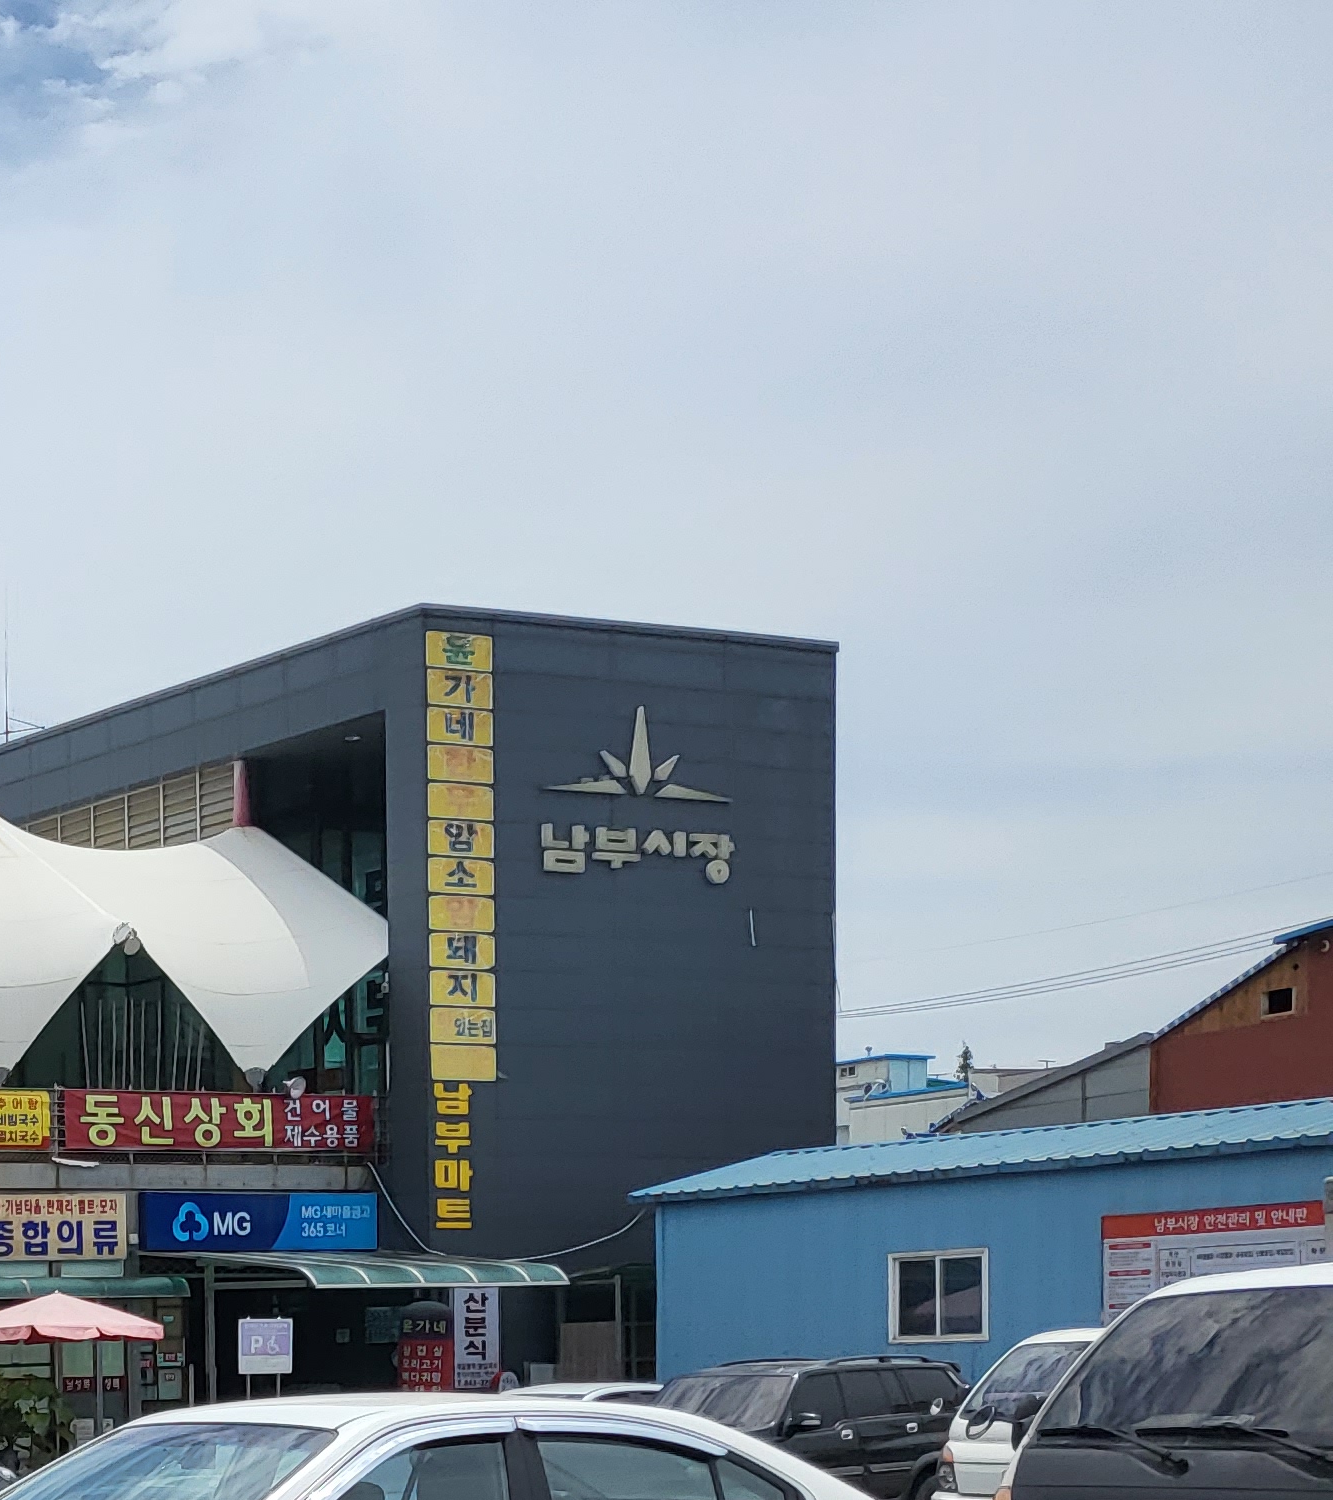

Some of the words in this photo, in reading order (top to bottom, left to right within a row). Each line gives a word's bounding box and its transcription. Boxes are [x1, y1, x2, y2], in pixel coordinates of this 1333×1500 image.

[540, 822, 736, 885] 남부시장
[80, 1094, 274, 1148] 동신상회
[284, 1125, 360, 1147] 제수용품
[433, 1081, 473, 1230] 남부마트
[213, 1211, 251, 1236] MG
[301, 1222, 324, 1237] 365
[1155, 1217, 1199, 1232] 남부시장
[1204, 1212, 1250, 1230] 안전관리
[1271, 1207, 1307, 1224] 안내판
[251, 1336, 264, 1354] P
